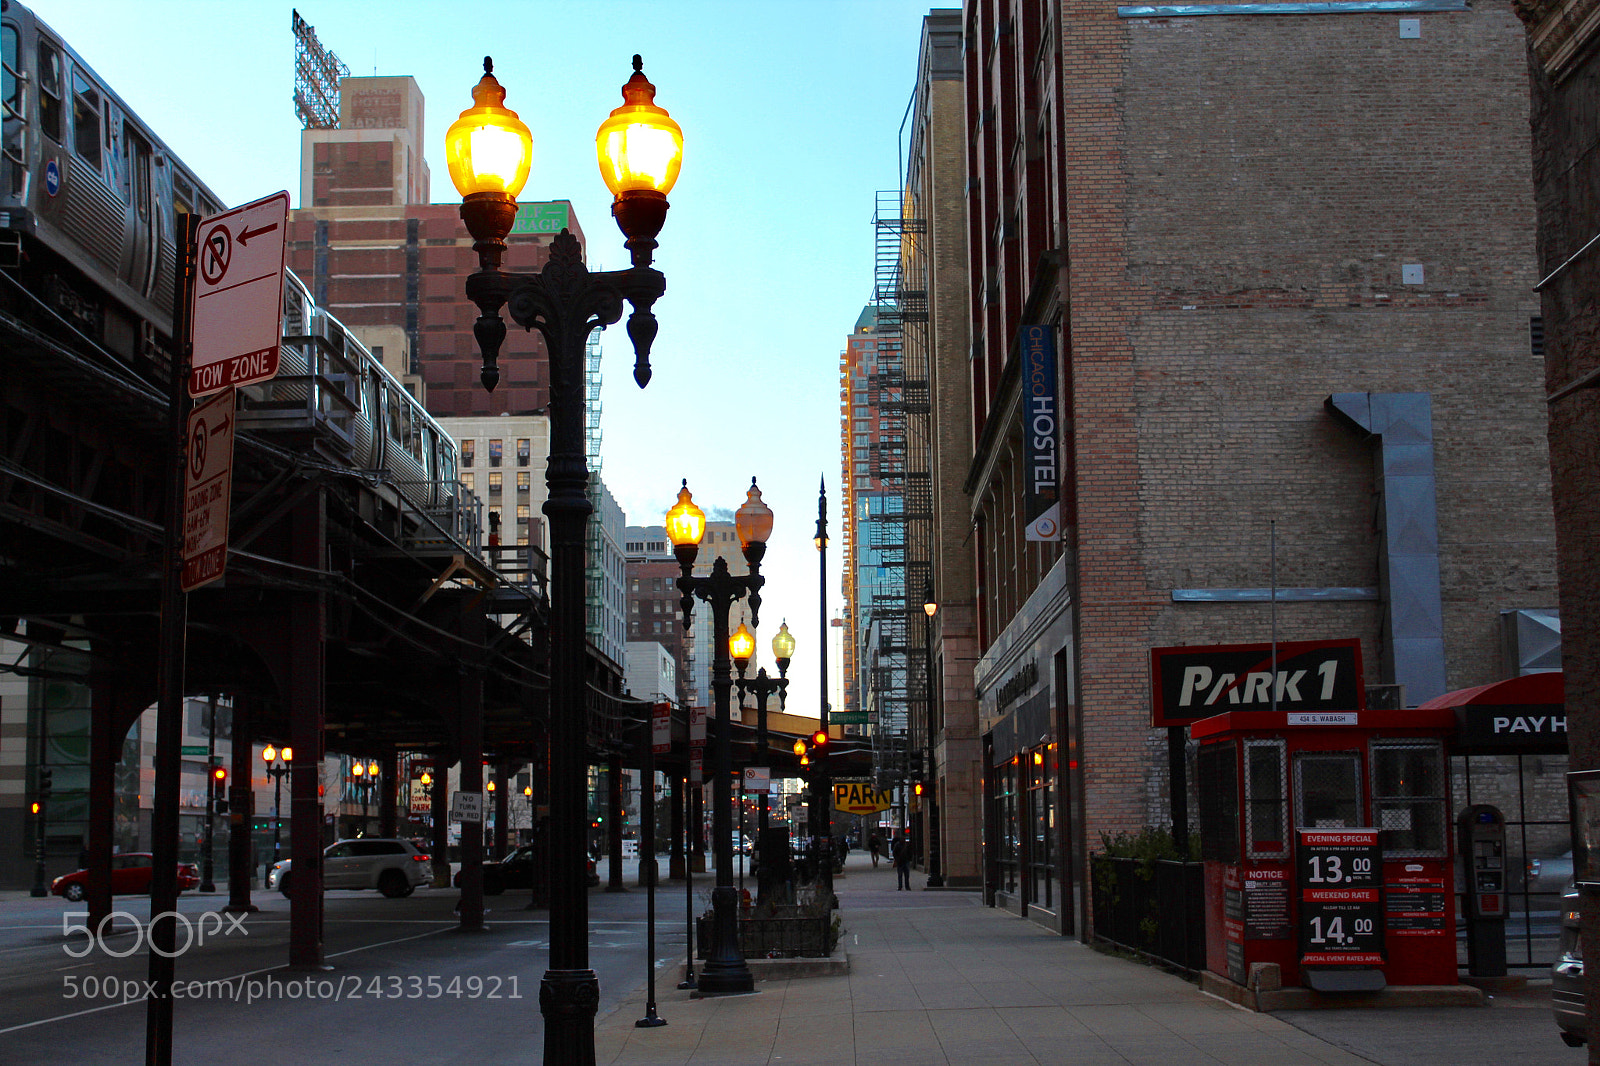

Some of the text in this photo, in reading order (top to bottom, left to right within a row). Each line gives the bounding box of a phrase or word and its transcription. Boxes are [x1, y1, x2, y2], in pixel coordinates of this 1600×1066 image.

[516, 206, 543, 218] ELF
[513, 218, 561, 231] RAGE
[194, 351, 270, 391] TOW ZONE
[1178, 659, 1338, 707] PARK 1
[1319, 715, 1346, 723] WABASH
[836, 784, 888, 805] PARK
[459, 803, 477, 811] TURN
[467, 812, 480, 820] RED
[1307, 835, 1373, 843] EVENING SPECIAL
[1249, 870, 1284, 879] NOTICE
[1312, 891, 1370, 899] WEEKEND RATE
